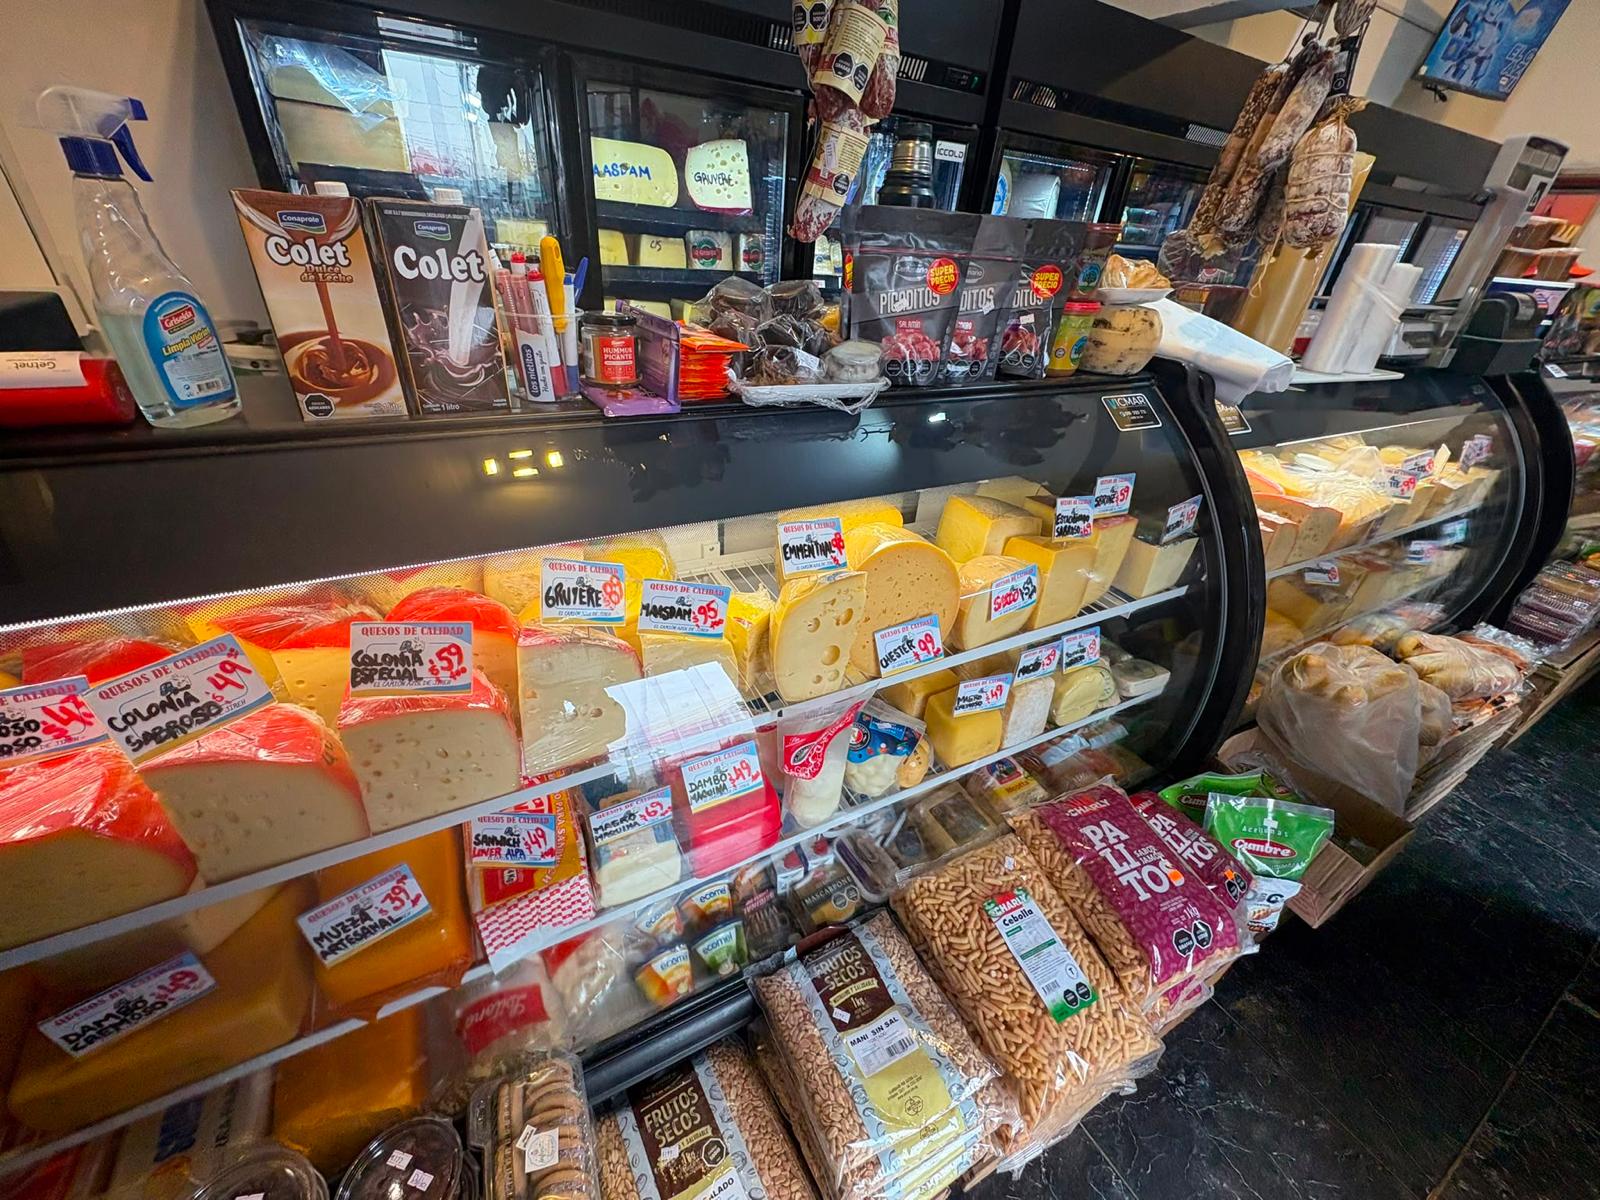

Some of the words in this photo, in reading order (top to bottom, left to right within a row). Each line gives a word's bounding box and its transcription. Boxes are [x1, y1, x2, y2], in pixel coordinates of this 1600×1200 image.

[694, 171, 734, 187] GRUYERE
[281, 213, 320, 225] Conaprole
[417, 223, 448, 234] Conaprole
[266, 235, 350, 267] Colet
[305, 264, 341, 274] Dulce
[393, 245, 486, 282] Colet
[930, 264, 954, 277] SUPER
[319, 273, 353, 283] Leche
[930, 275, 955, 286] PRECIO
[1034, 280, 1058, 290] PRECIO
[1035, 272, 1059, 282] SUPER
[164, 311, 193, 328] Griselda
[162, 338, 191, 356] Limpia
[549, 562, 577, 571] QUESOS
[590, 565, 619, 575] CALIDAD
[545, 582, 603, 608] GRUYERE
[650, 583, 678, 593] QUESOS
[692, 587, 724, 597] CALIDAD
[361, 626, 400, 636] QUESOS
[404, 626, 417, 635] DE
[421, 626, 464, 636] CALIDAD
[351, 648, 424, 668] COLONIA
[880, 638, 916, 668] CHESTER
[99, 675, 150, 700] QUESOS
[151, 664, 172, 680] DE
[173, 642, 228, 670] CALIDAD
[351, 667, 424, 688] ESPECIAL
[13, 684, 77, 703] CALIDAD
[107, 690, 200, 733] COLONIA
[125, 701, 224, 752] SABROSO
[688, 773, 728, 793] DAMBO
[1068, 799, 1111, 817] CHARLY
[478, 815, 506, 824] QUESOS
[518, 816, 550, 825] CALIDAD
[593, 813, 637, 835] MAGRO
[1150, 813, 1177, 836] PA
[1080, 820, 1130, 850] PA
[1164, 828, 1192, 854] LI
[1182, 837, 1219, 868] TOS
[1234, 839, 1292, 856] Cumbre
[1099, 843, 1141, 876] LI
[1119, 858, 1177, 901] TOS
[307, 902, 346, 924] QUESOS
[346, 892, 361, 903] DE
[1002, 909, 1034, 927] Cebolla
[312, 910, 374, 949] MUZZA
[320, 914, 403, 961] ARTESANAL
[702, 932, 733, 954] ecomel
[811, 945, 862, 978] FRUTOS
[824, 961, 866, 991] SECOS
[60, 996, 149, 1045] DAMBO
[850, 1034, 869, 1047] MANI
[870, 1025, 885, 1036] SIN
[885, 1016, 900, 1029] SAL
[644, 1086, 699, 1133] FRUTOS
[654, 1106, 701, 1148] SECOS
